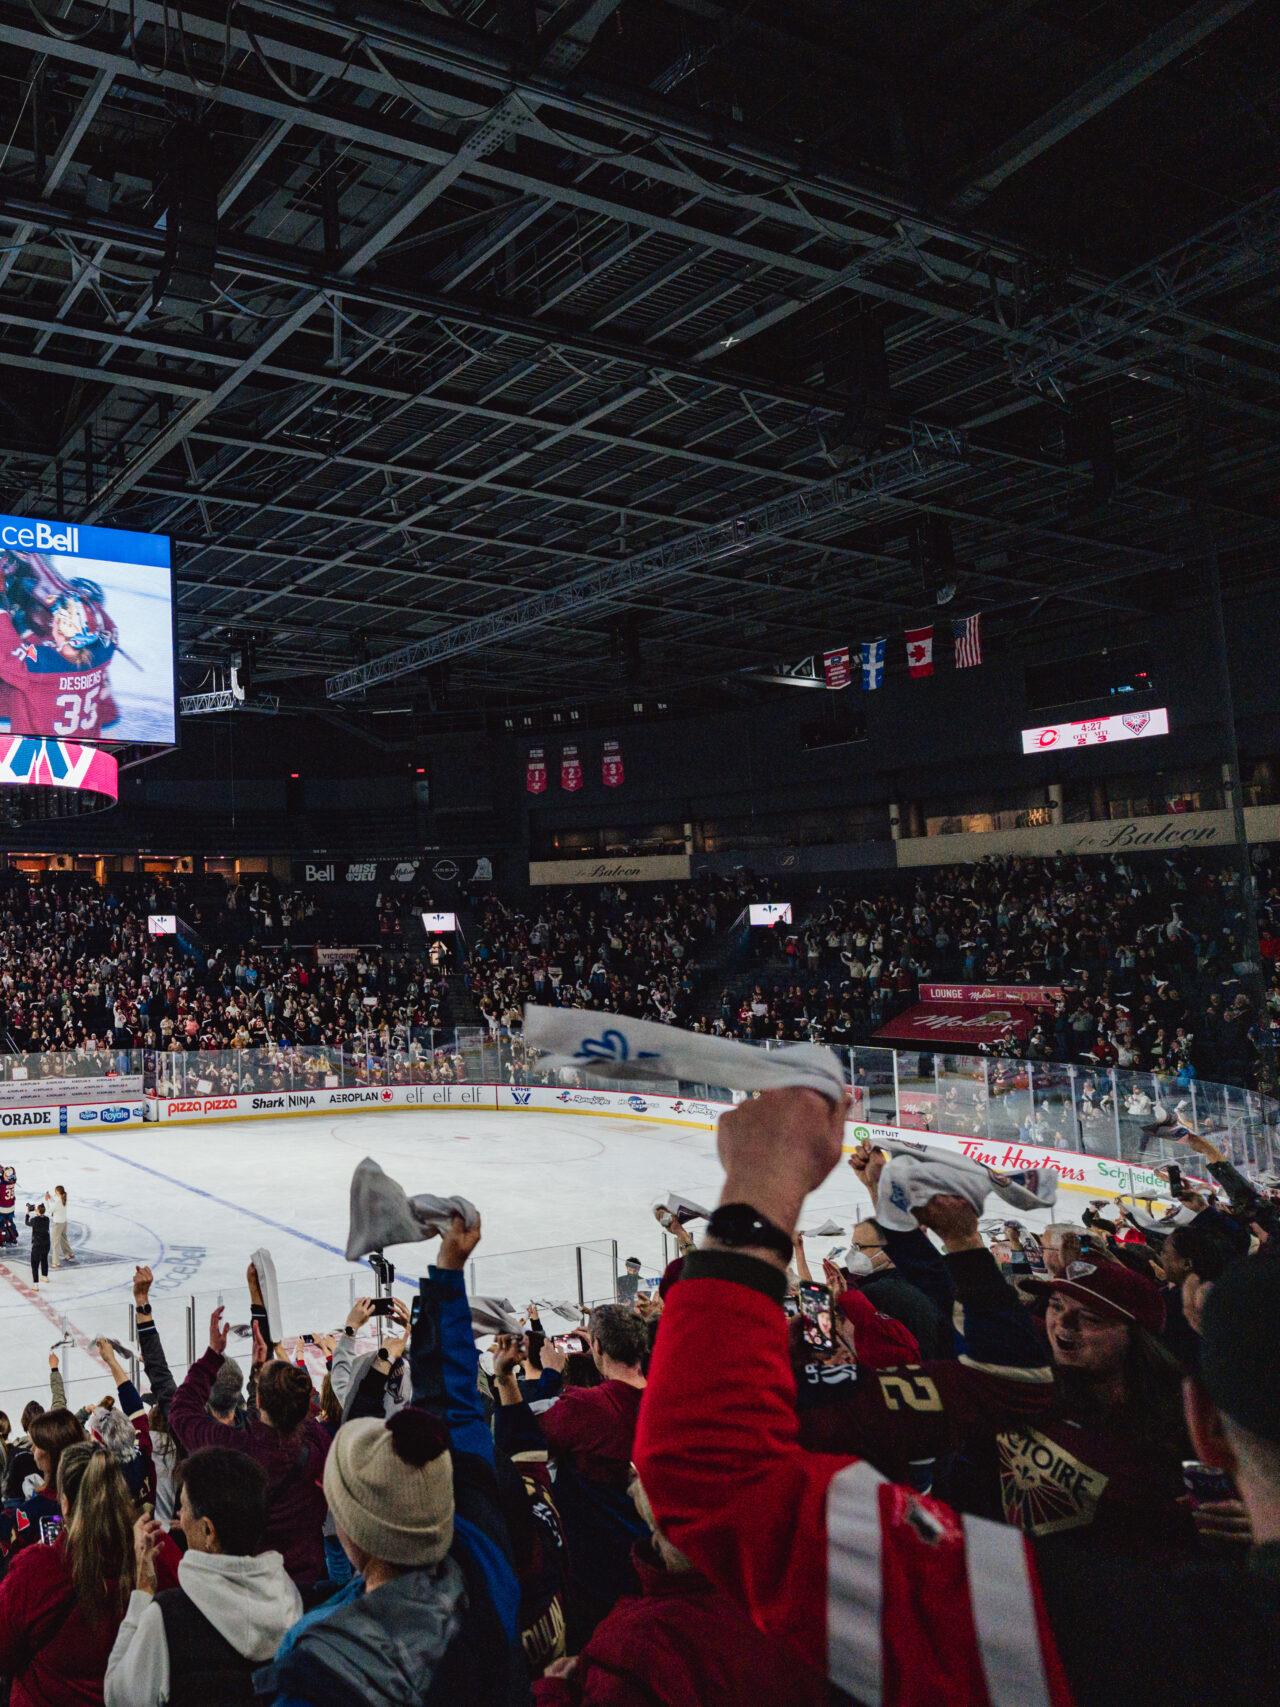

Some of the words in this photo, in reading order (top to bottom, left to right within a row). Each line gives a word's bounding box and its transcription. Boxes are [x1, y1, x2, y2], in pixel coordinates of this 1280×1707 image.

[53, 688, 98, 736] 35
[1081, 721, 1102, 732] 4:27
[568, 768, 575, 778] 2
[609, 764, 617, 775] 3
[1101, 823, 1218, 848] Balcon
[305, 864, 336, 881] Bell
[930, 988, 963, 999] LOUNGE
[913, 1014, 1024, 1030] Molson
[329, 1091, 379, 1103] AEROPLAN
[406, 1087, 425, 1103] elf
[433, 1087, 452, 1103] elf
[461, 1087, 483, 1103] elf
[168, 1101, 201, 1116] pizza
[204, 1099, 237, 1114] pizza
[252, 1097, 284, 1109] Shark
[102, 1110, 129, 1122] Royale
[872, 1128, 898, 1138] INTUIT
[958, 1140, 996, 1165] Tim
[1001, 1146, 1087, 1182] Hortons
